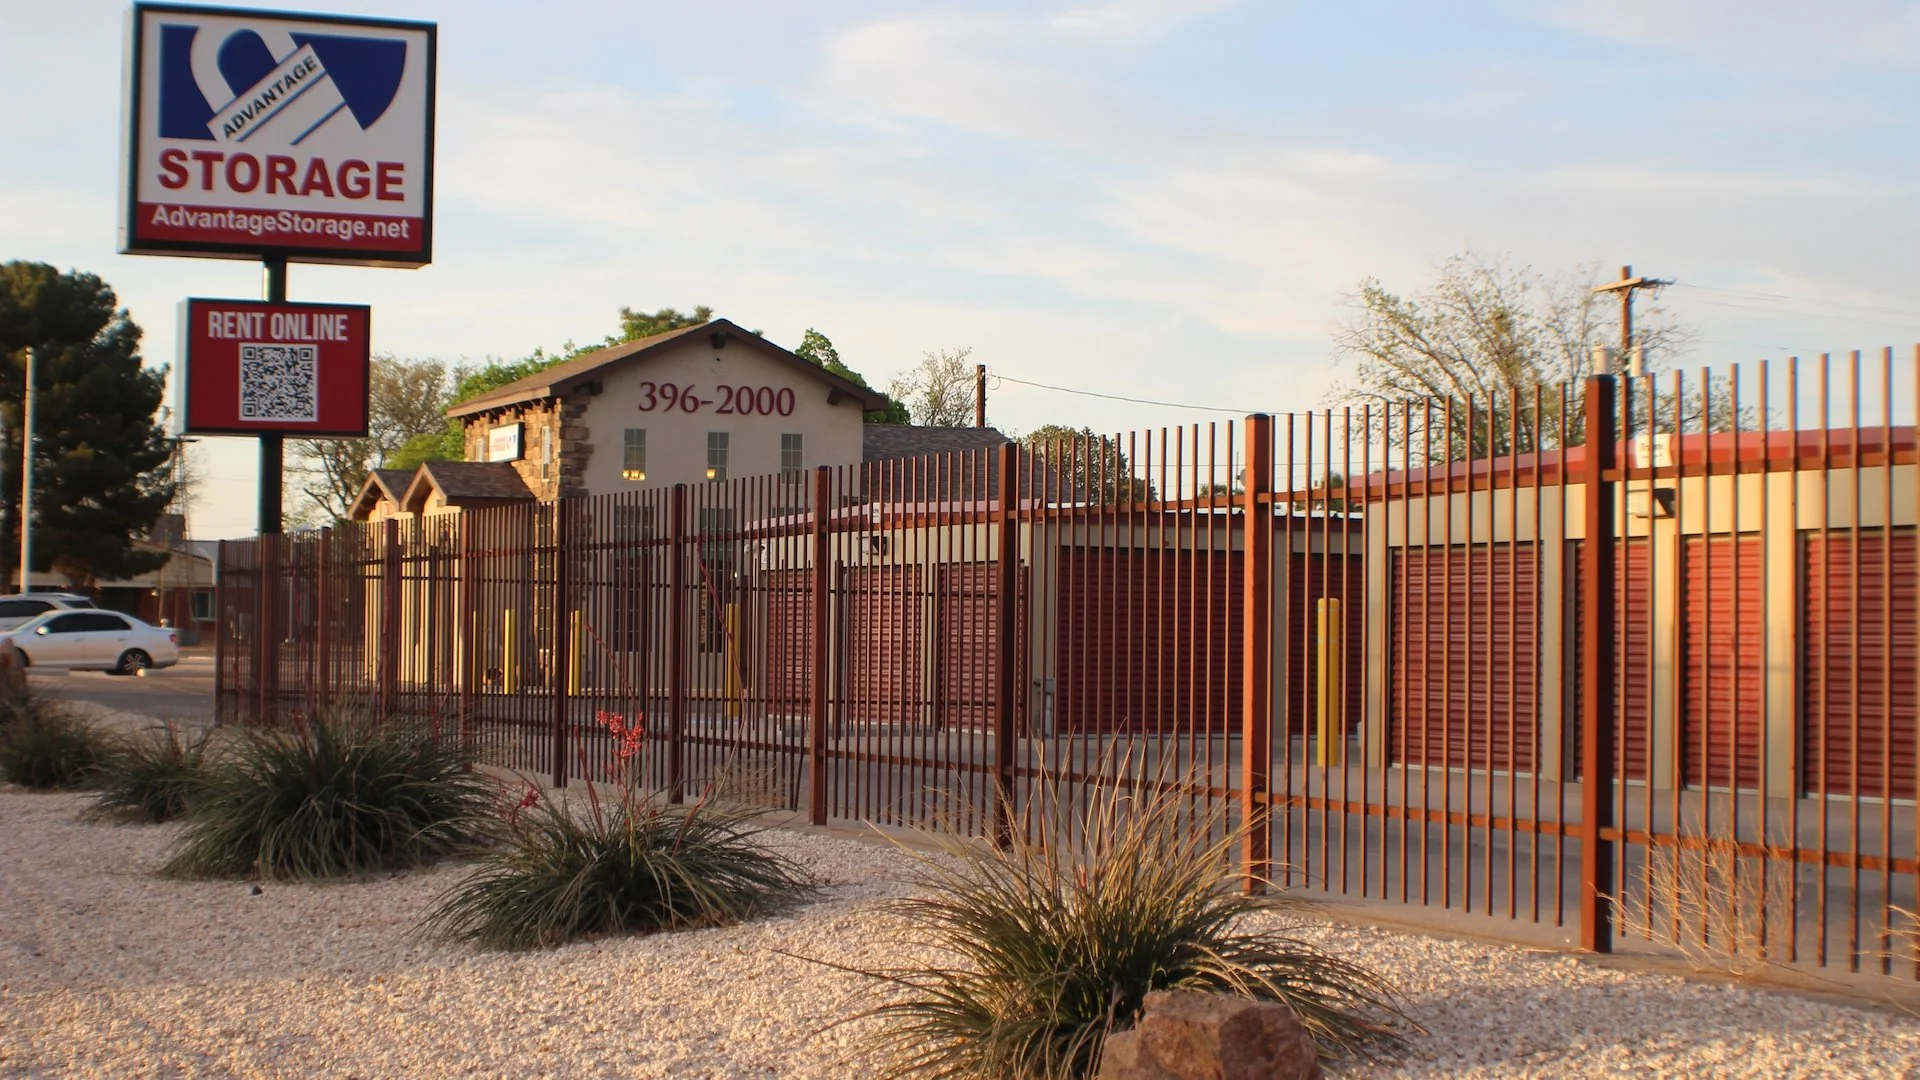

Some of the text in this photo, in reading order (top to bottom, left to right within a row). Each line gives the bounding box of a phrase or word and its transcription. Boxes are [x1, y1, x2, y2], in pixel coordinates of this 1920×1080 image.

[223, 55, 318, 139] ADVANTAGE
[157, 147, 405, 202] STORAGE
[152, 204, 410, 240] AdvantageStorage.net
[207, 311, 348, 341] RENT ONLINE
[638, 381, 796, 417] 396-2000
